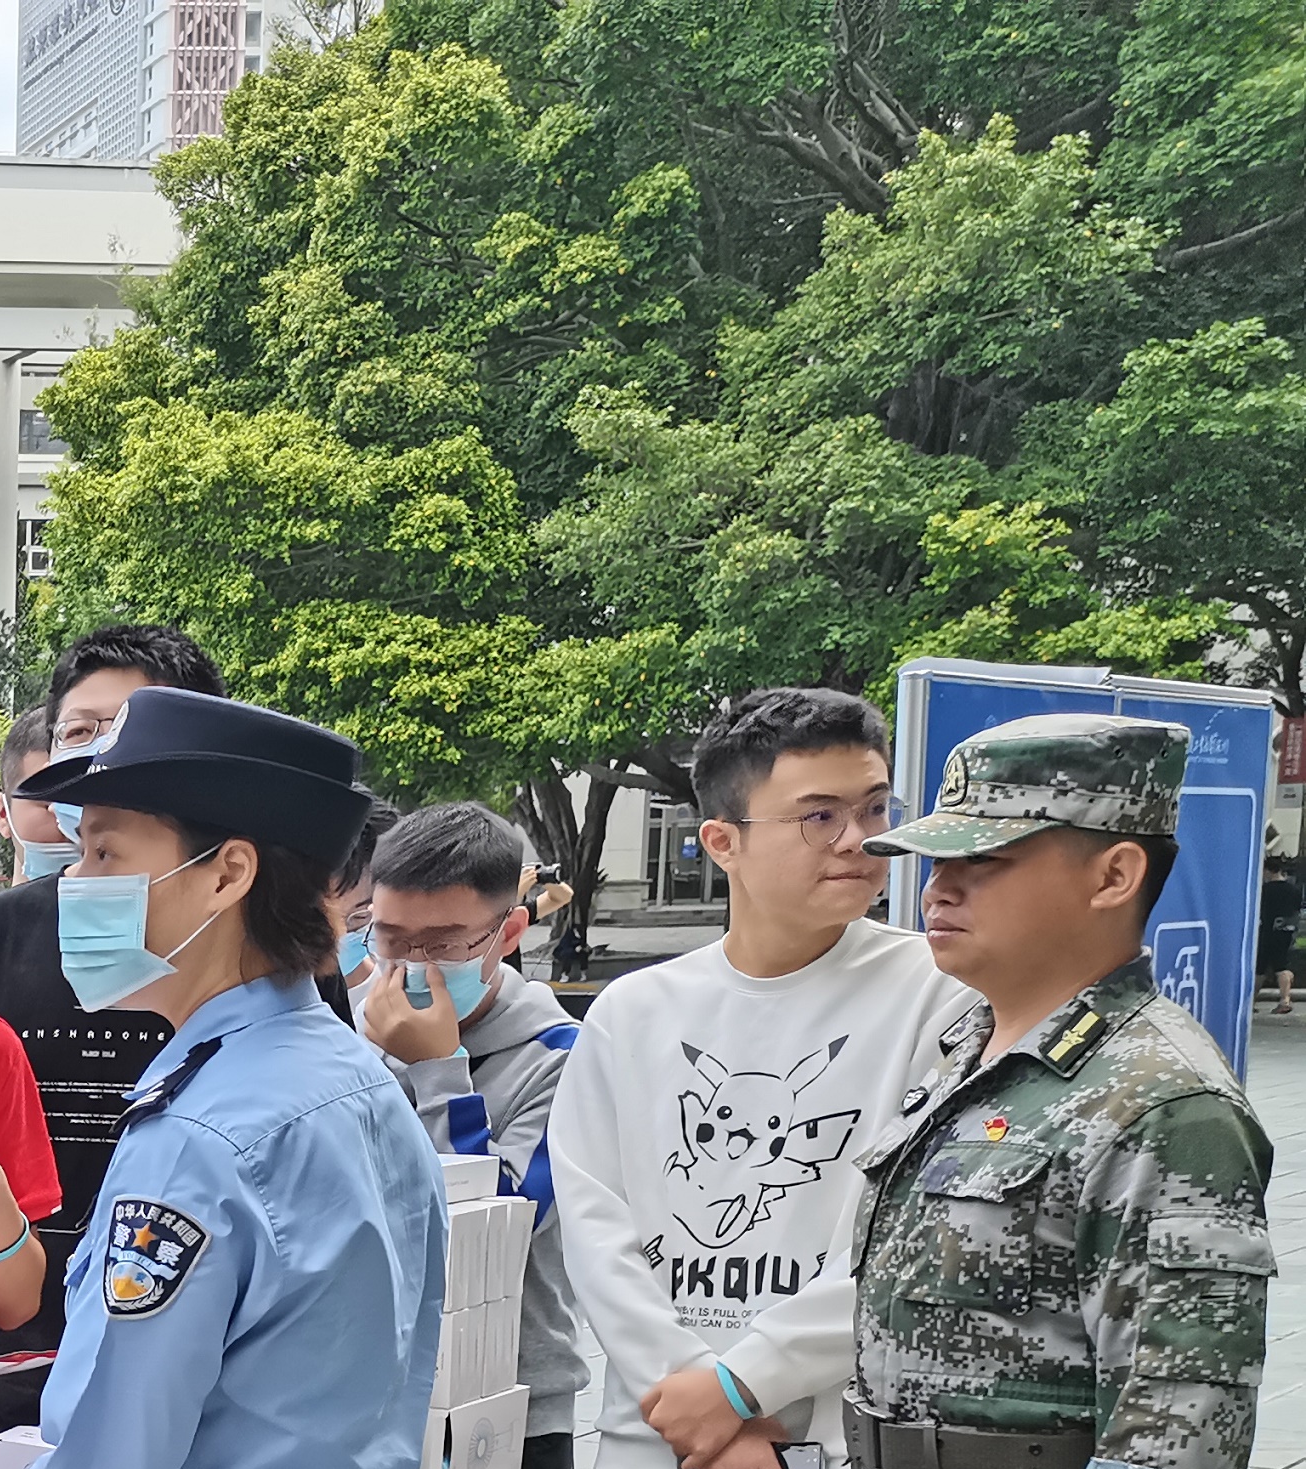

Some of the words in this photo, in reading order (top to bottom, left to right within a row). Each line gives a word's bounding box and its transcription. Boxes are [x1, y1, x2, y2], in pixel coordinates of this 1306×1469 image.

[713, 1308, 738, 1319] FULL
[701, 1318, 722, 1329] CAN
[726, 1320, 741, 1329] DO
